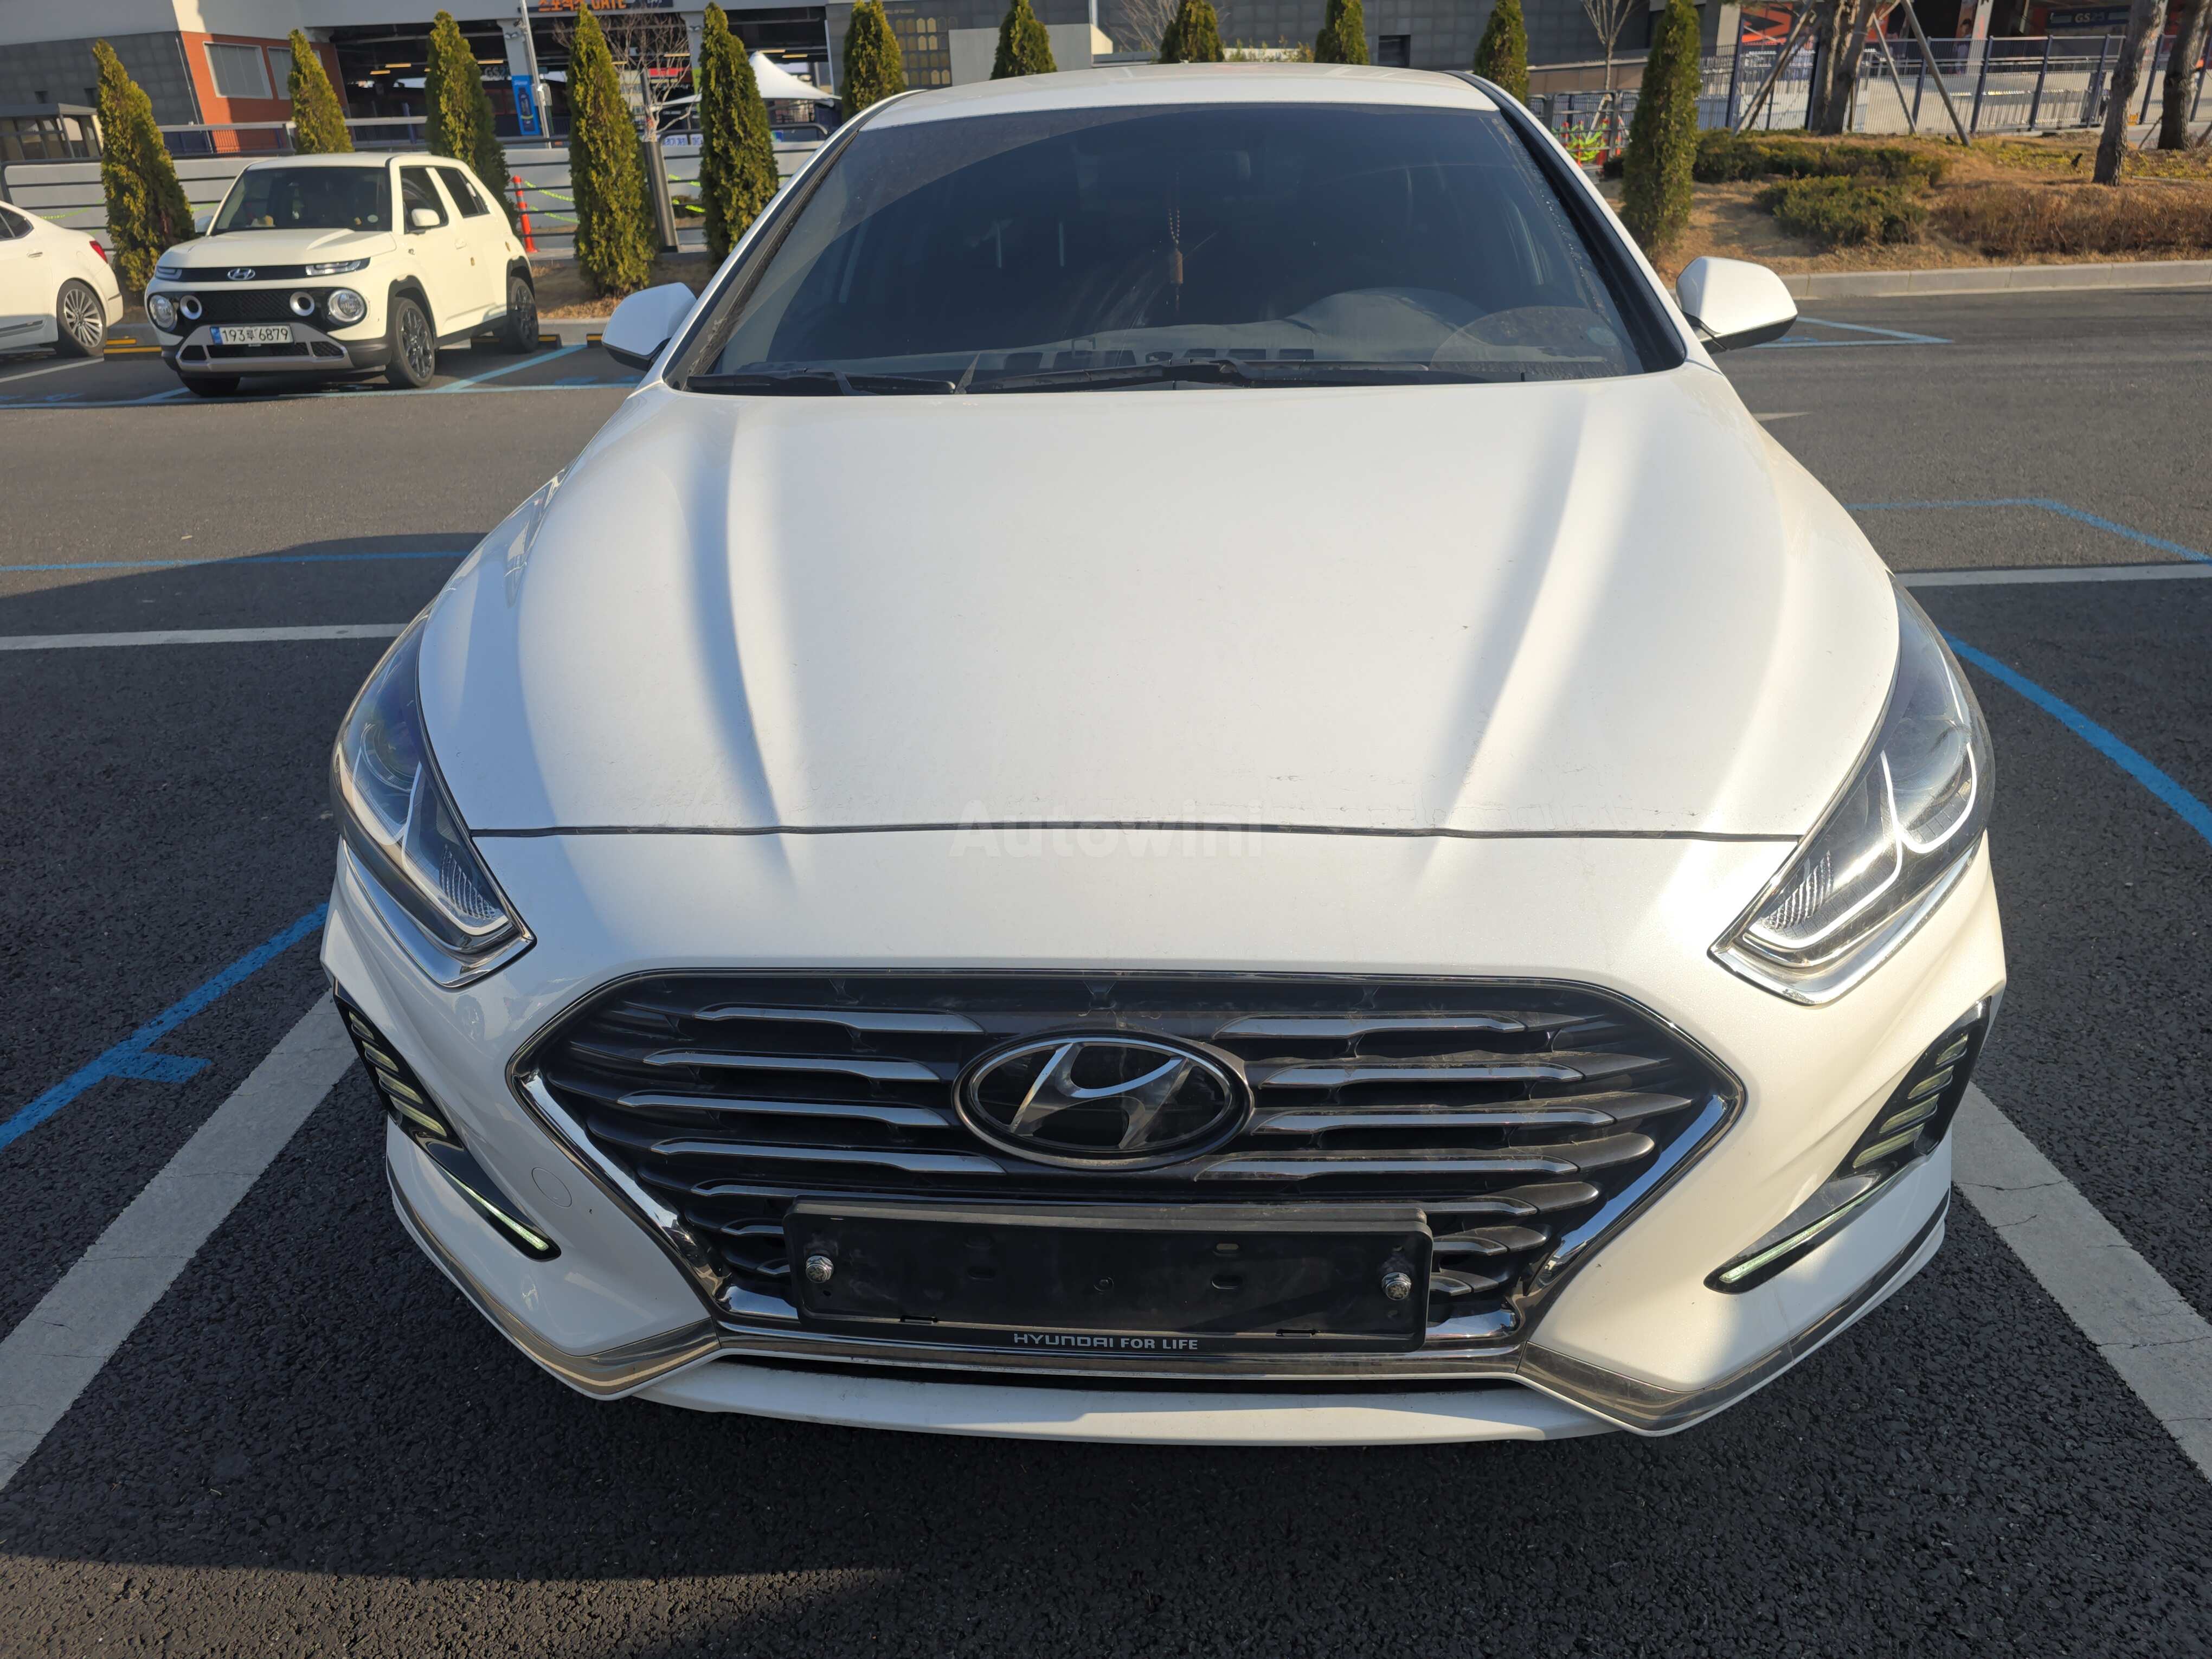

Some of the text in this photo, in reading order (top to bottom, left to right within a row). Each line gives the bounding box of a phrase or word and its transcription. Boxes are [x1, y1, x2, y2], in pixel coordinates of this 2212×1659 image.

[259, 328, 288, 342] 6879
[1013, 1333, 1198, 1350] HYUNDAI FOR LIFE
